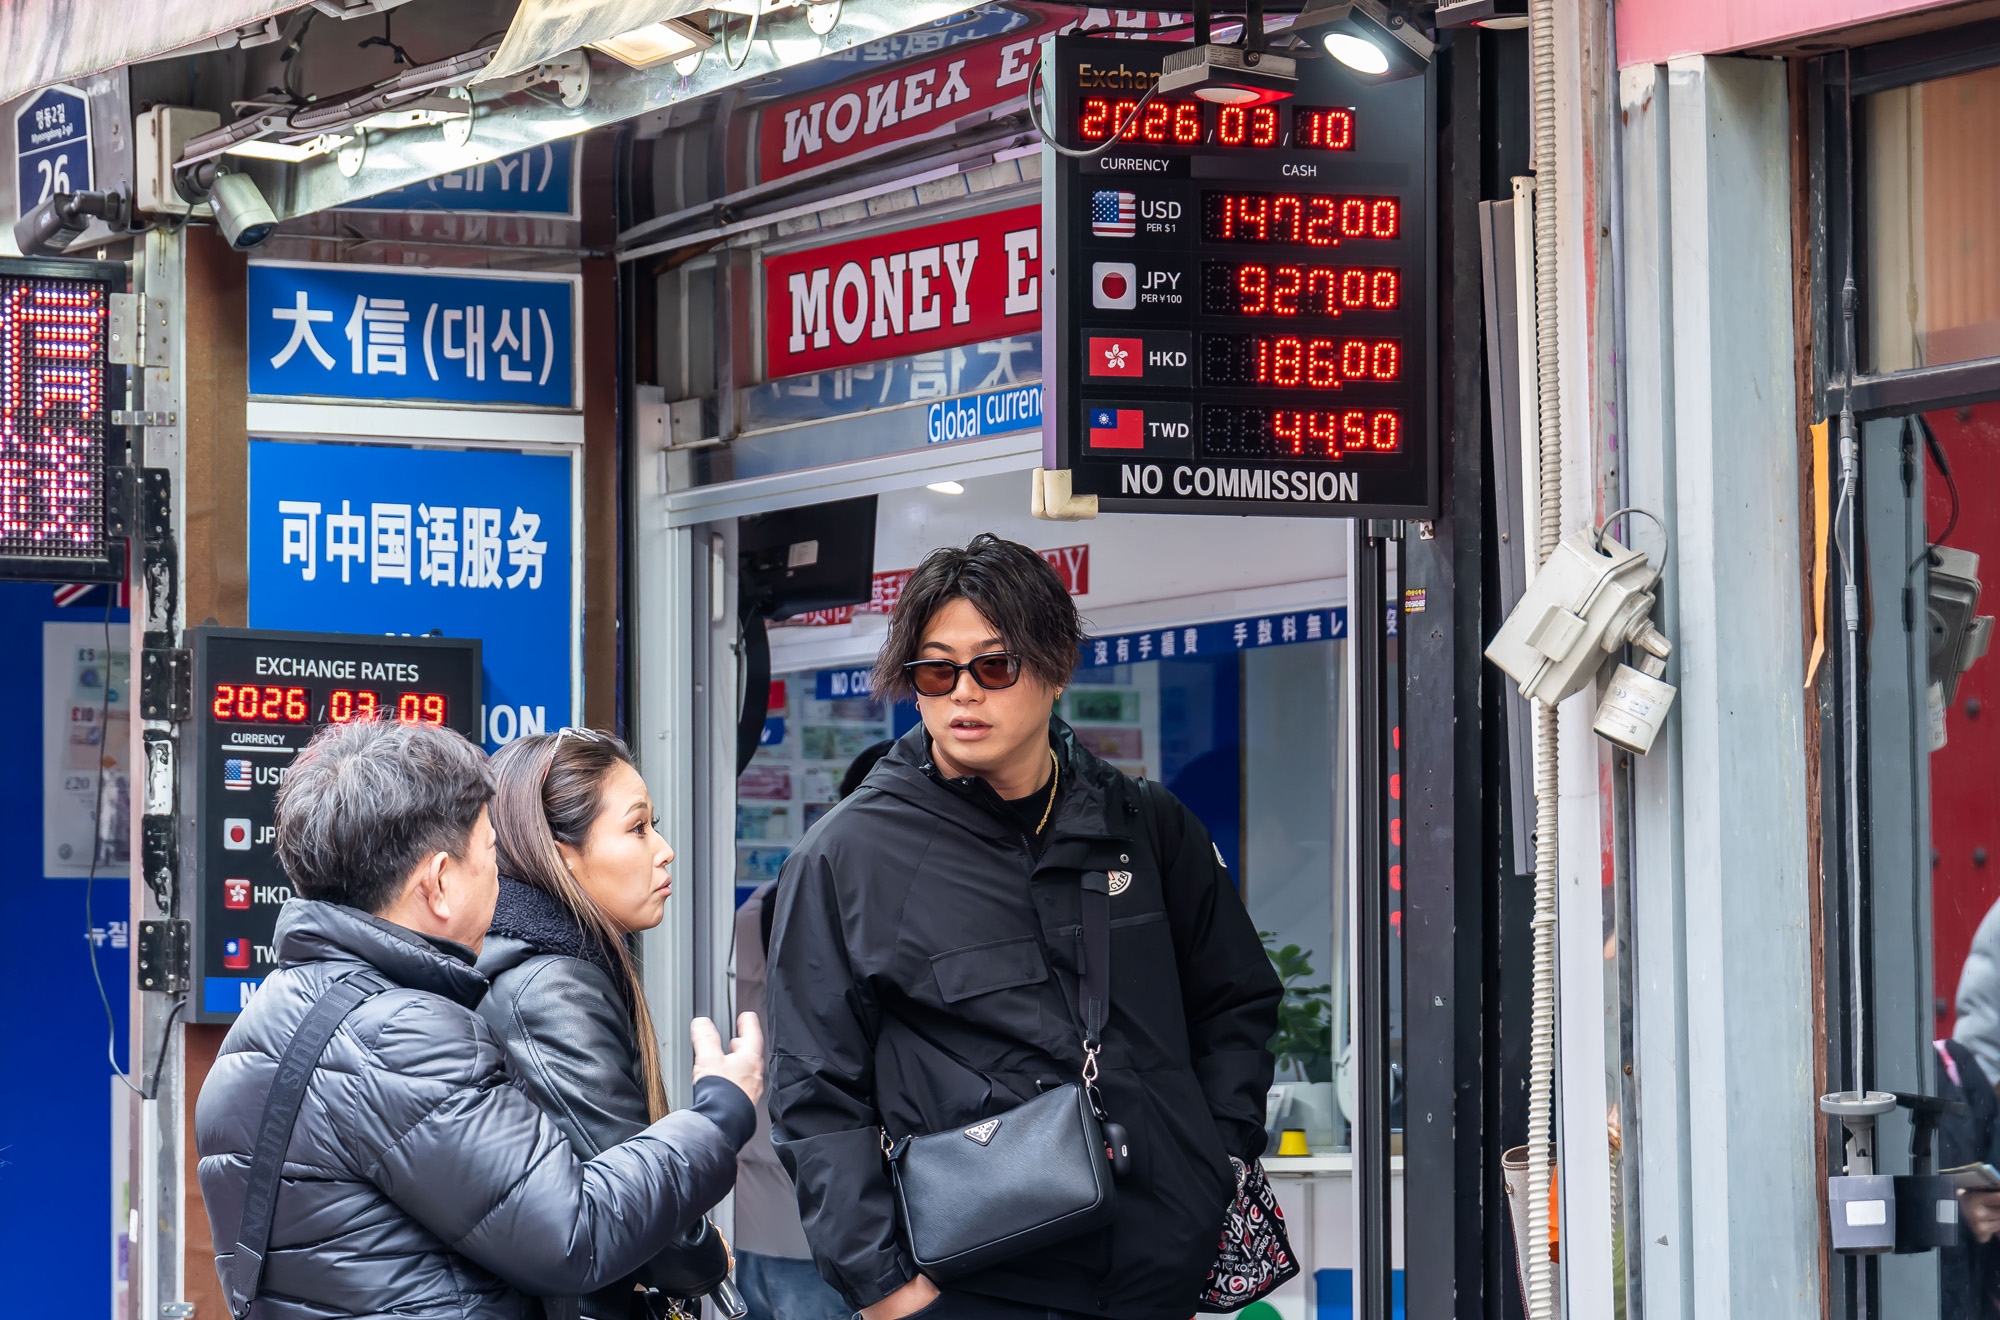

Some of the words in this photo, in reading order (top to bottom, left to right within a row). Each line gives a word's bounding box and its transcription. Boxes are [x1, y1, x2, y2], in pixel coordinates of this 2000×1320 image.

[35, 102, 66, 130] 명동2길
[1083, 100, 1199, 142] 2026
[1221, 106, 1274, 144] 03
[1311, 112, 1350, 149] 10
[37, 154, 70, 206] 26
[1100, 157, 1170, 173] CURRENCY
[1282, 164, 1317, 178] CASH
[1141, 200, 1182, 219] USD
[1222, 196, 1398, 247] 1472.00
[1146, 223, 1162, 232] PER
[788, 238, 979, 354] MONEY
[1141, 271, 1182, 290] JPY
[1238, 265, 1398, 316] 927.00
[1141, 293, 1159, 303] PER
[269, 290, 555, 387] 大信(대신)
[1149, 351, 1187, 367] HKD
[1256, 338, 1398, 387] 186.00
[928, 394, 981, 443] Global
[986, 387, 1042, 425] curren
[1149, 422, 1190, 439] TWD
[1274, 411, 1398, 458] 44.50
[1121, 465, 1164, 495] NO
[1173, 467, 1358, 502] COMMISSION
[278, 499, 548, 590] 可中国语服务
[256, 657, 356, 680] EXCHANGE
[361, 661, 420, 683] RATES
[214, 685, 306, 721] 2026
[330, 690, 377, 723] 03
[400, 695, 445, 726] 09
[231, 732, 286, 746] CURRENCY
[254, 886, 292, 905] HKD
